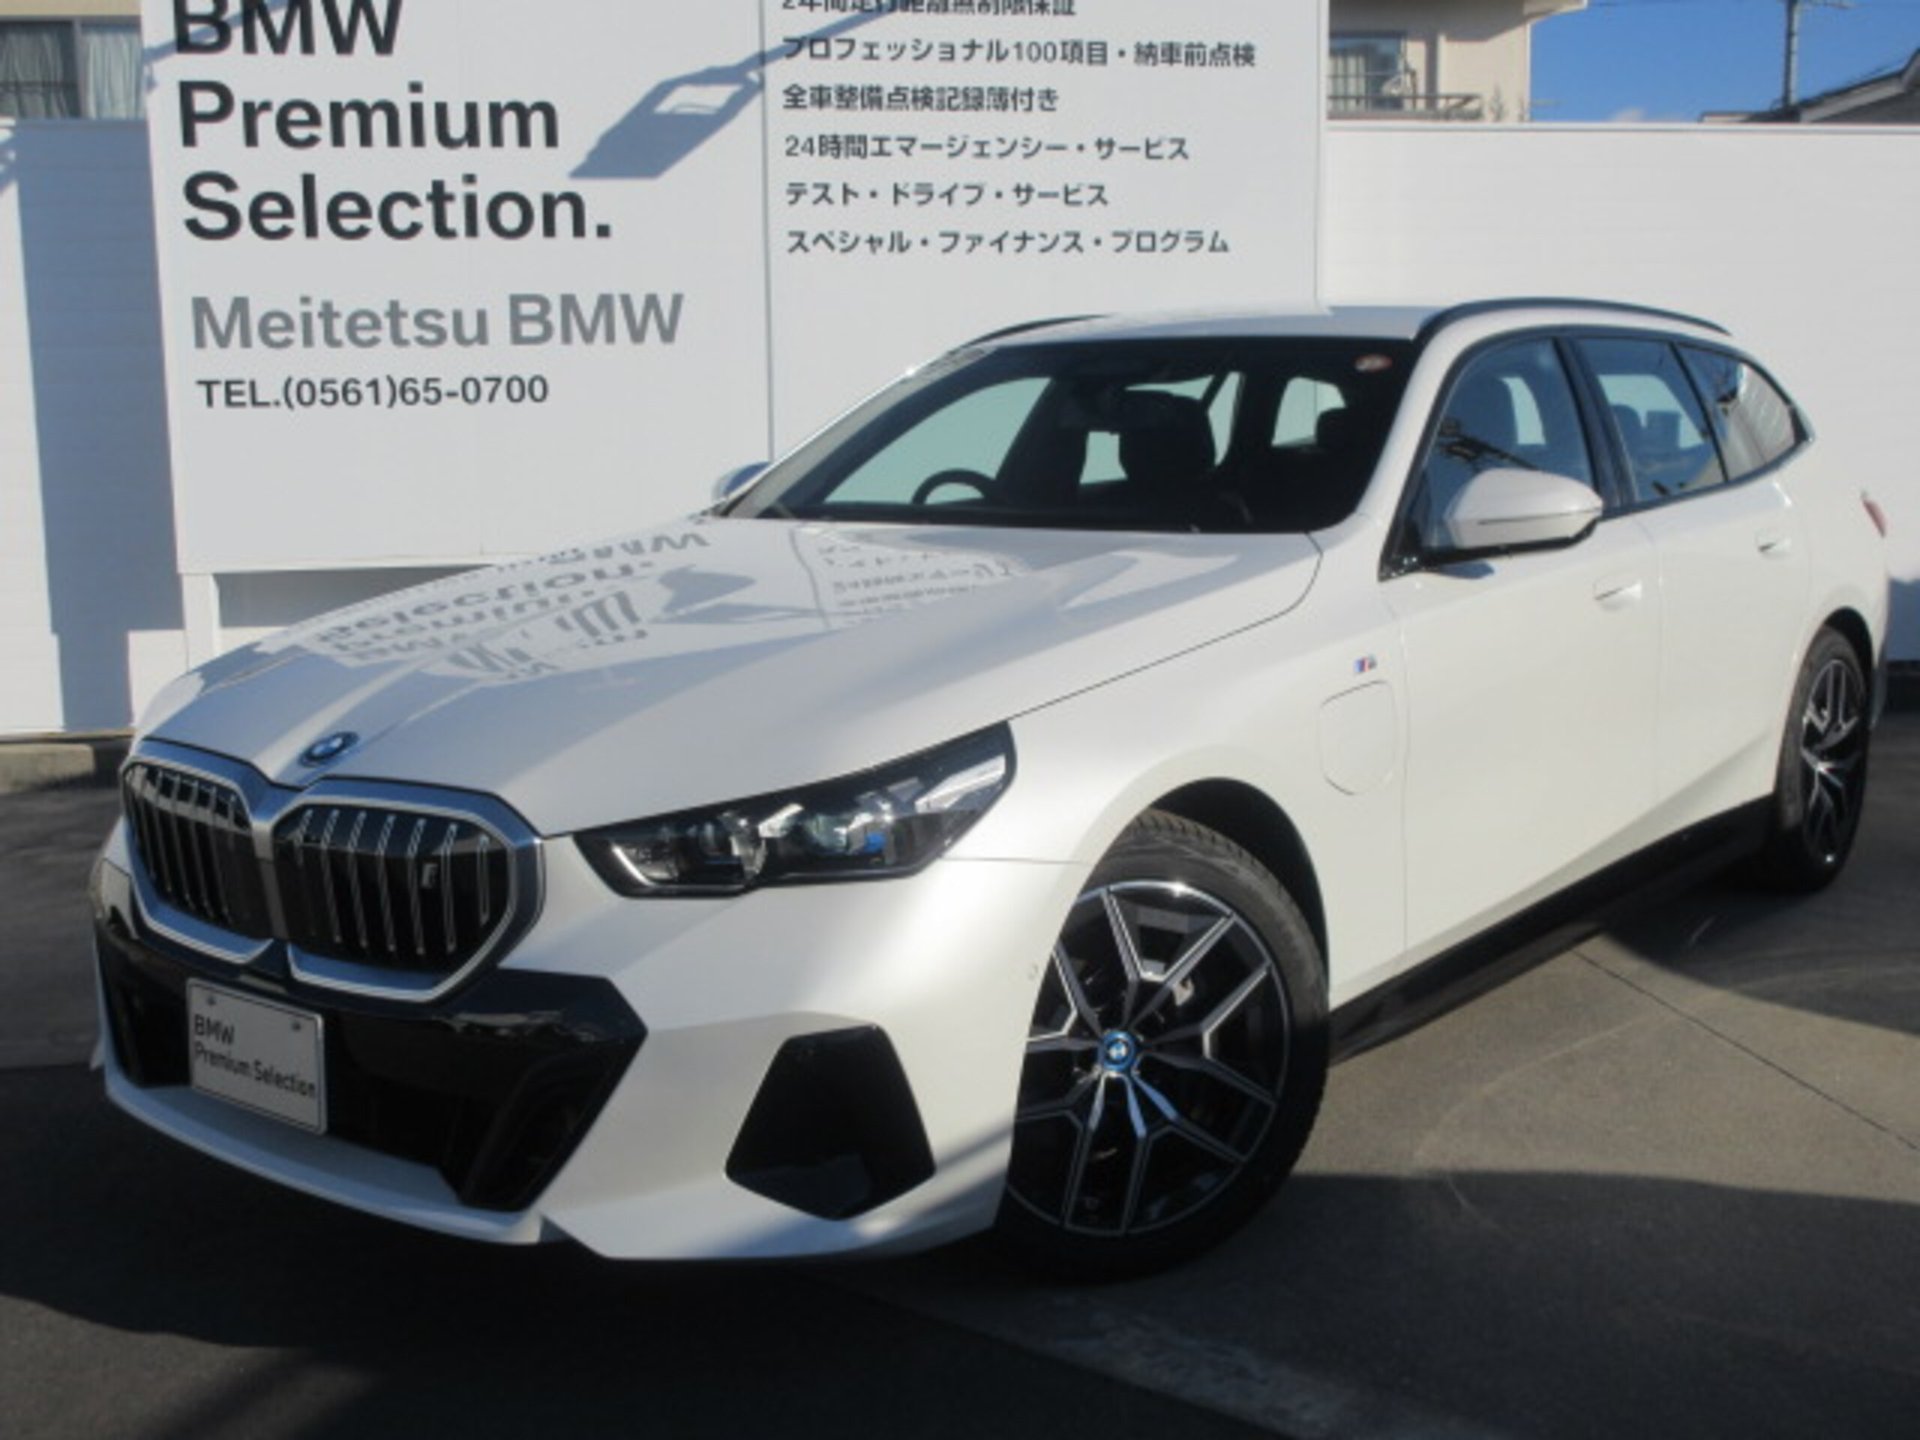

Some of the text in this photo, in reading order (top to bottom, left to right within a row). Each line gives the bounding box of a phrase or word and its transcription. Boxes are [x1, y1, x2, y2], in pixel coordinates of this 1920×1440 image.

[174, 0, 402, 55] BMW
[177, 79, 559, 149] Premium
[782, 83, 1059, 112] 全車整備点検記録簿付き
[785, 133, 1190, 161] 24時間エマージェンシー・サービス
[182, 170, 612, 240] Selection.
[786, 182, 1109, 207] テスト・ドライブ・サービス
[787, 230, 1230, 255] スペシャル・ファイナンス・プログラム
[190, 292, 685, 350] Meitetsu BMW
[195, 374, 550, 409] TEL.(0561)65-0700
[193, 1013, 236, 1045] BMW
